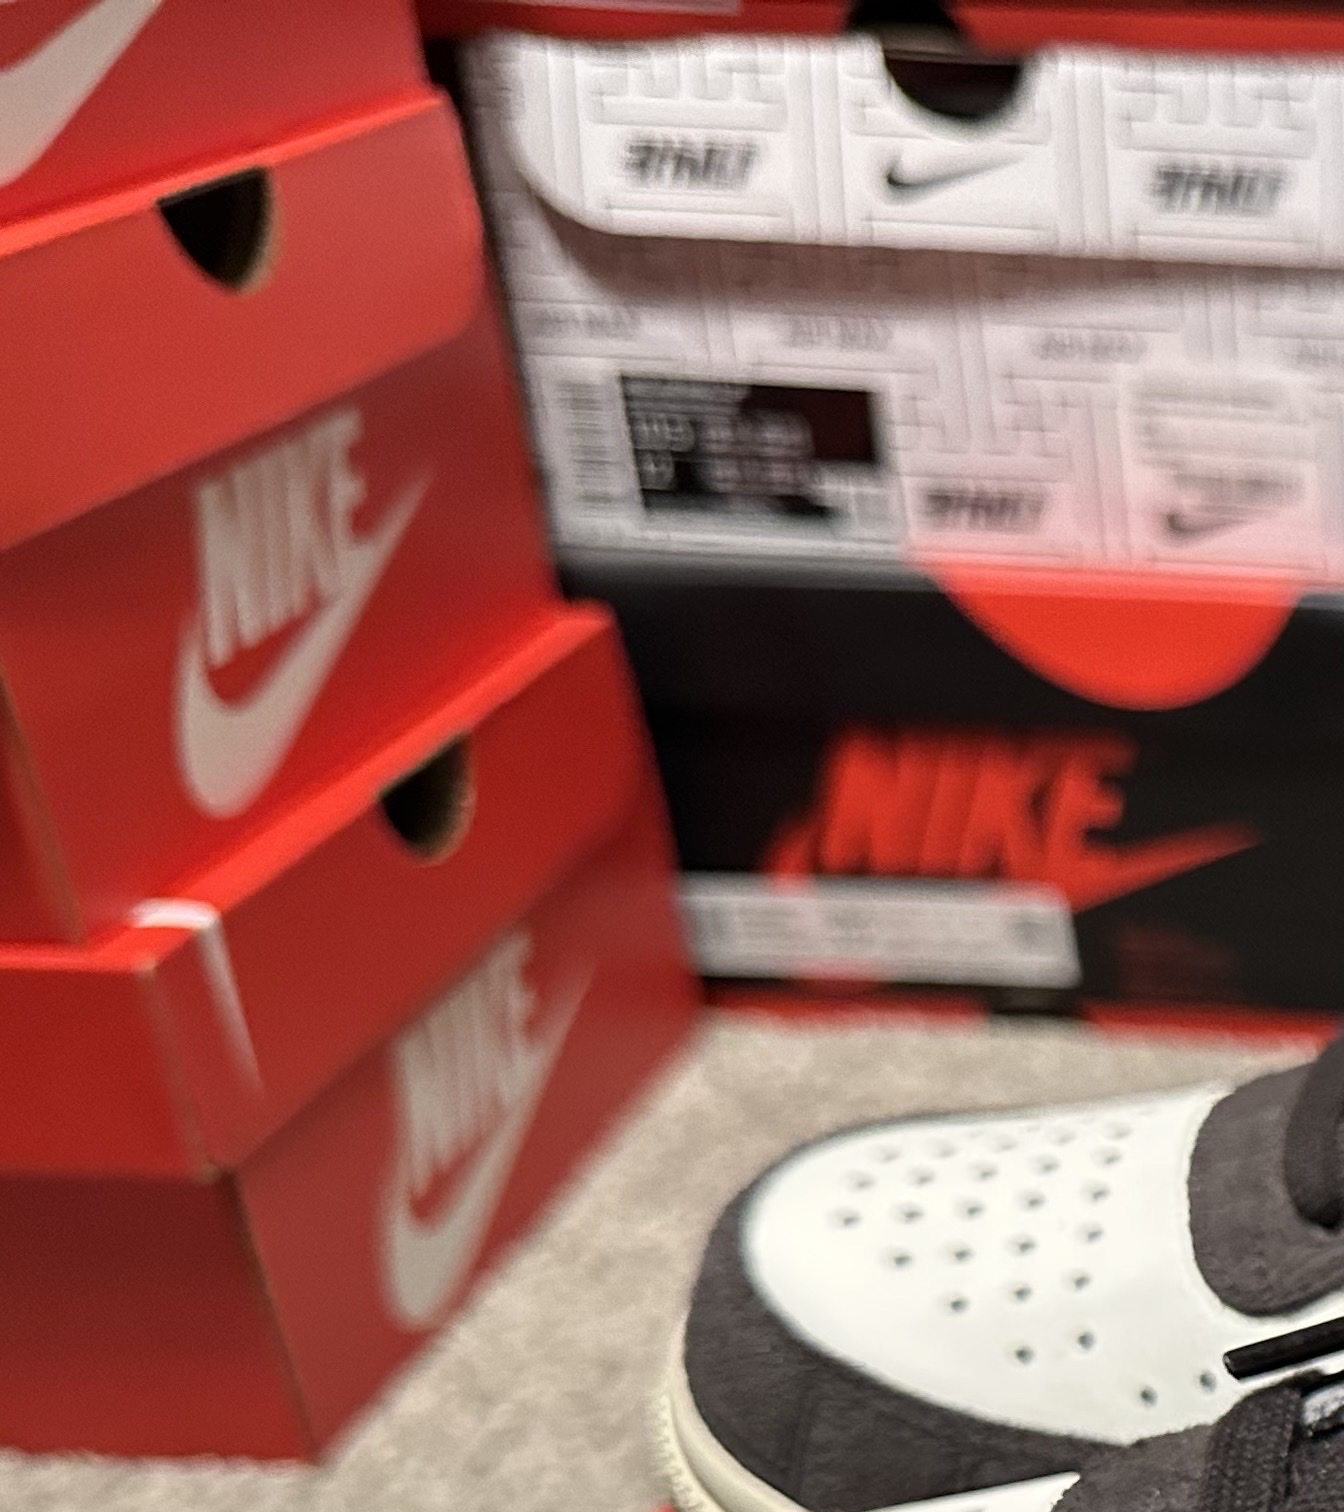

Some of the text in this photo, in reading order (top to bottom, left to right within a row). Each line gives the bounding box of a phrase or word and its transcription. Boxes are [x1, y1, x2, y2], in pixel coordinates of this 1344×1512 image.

[198, 406, 368, 668] NIKE
[822, 732, 1138, 888] NIKE
[397, 933, 536, 1197] NIKE
